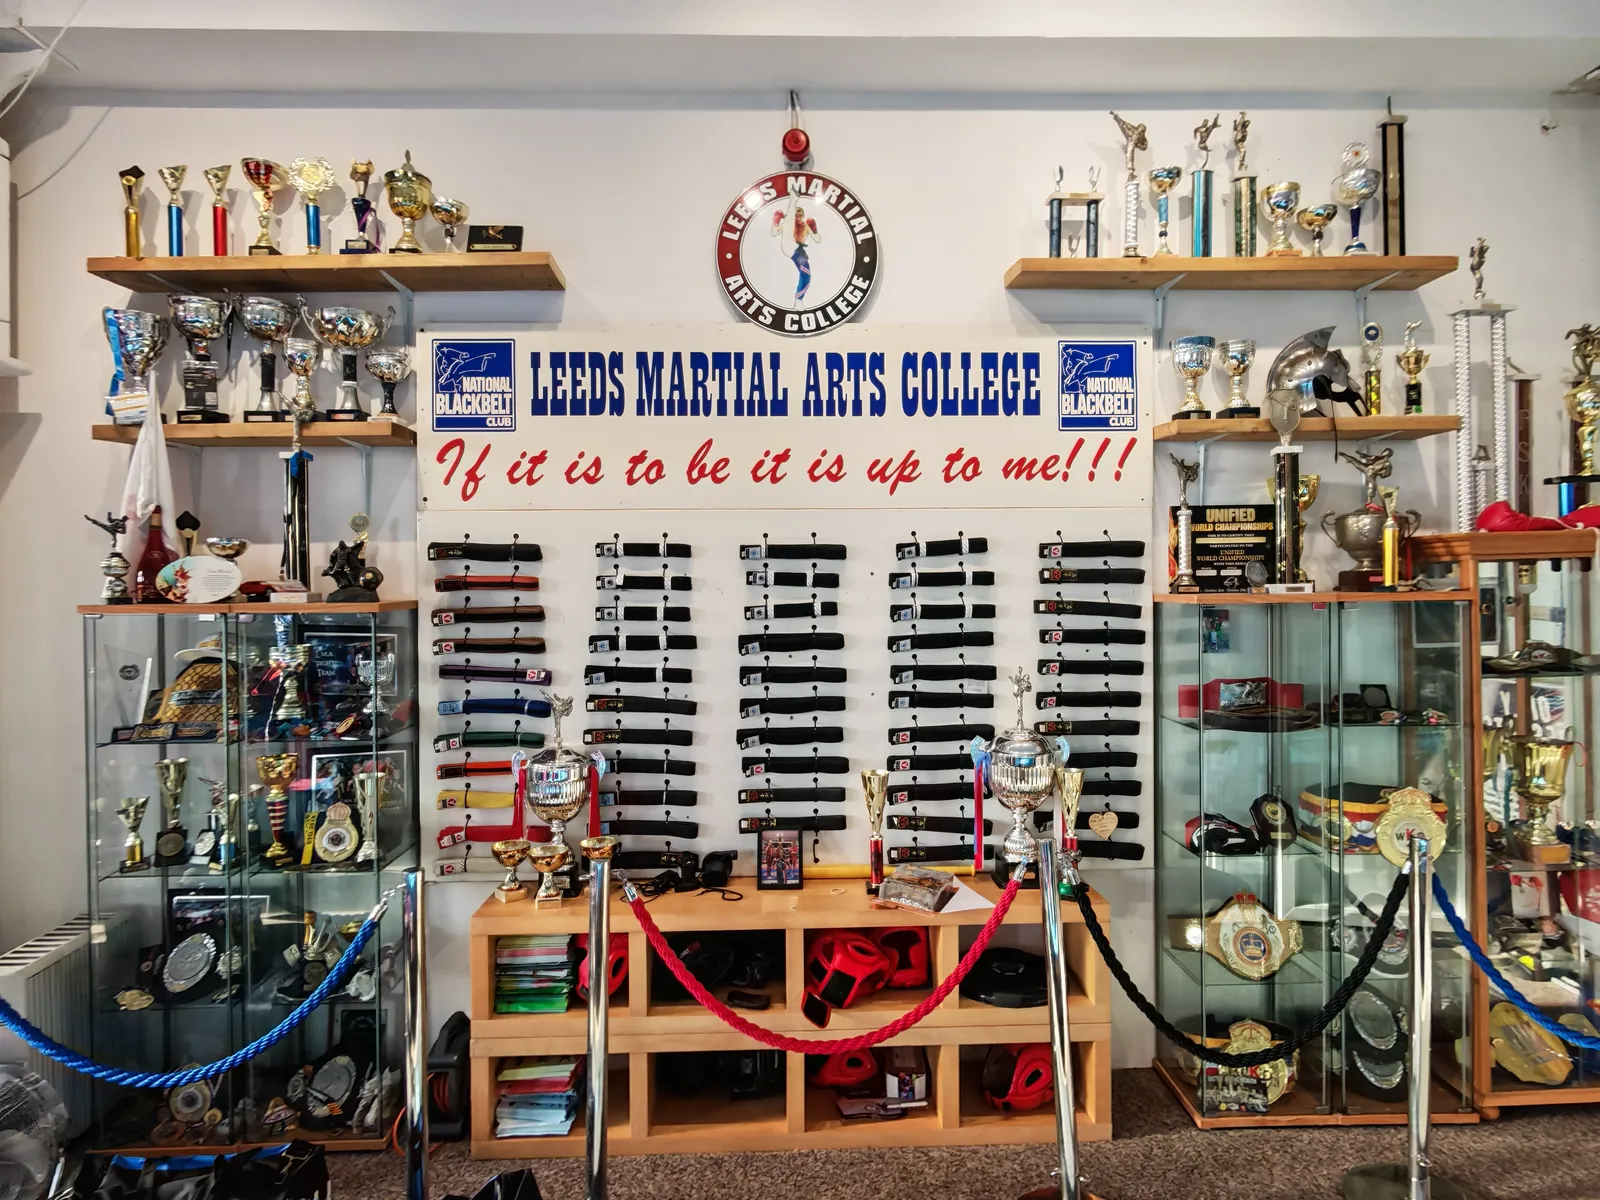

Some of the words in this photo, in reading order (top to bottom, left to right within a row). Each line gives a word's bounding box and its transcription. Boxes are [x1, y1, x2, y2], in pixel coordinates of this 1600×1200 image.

[722, 181, 778, 241] LEEDS
[786, 176, 874, 245] MARTIAL
[725, 274, 777, 325] ARTS
[784, 274, 870, 331] COLLEGE
[462, 376, 512, 393] NATIONAL
[530, 351, 625, 416] LEEDS
[636, 351, 789, 416] MARTIAL
[802, 352, 887, 416] ARTS
[901, 351, 1041, 417] COLLEGE
[1086, 376, 1134, 393] NATIONAL
[436, 393, 512, 415] BLACKBELT
[1061, 393, 1134, 416] BLACKBELT
[486, 417, 512, 427] CLUB
[1108, 417, 1134, 427] CLUB
[436, 437, 492, 502] If
[506, 449, 548, 485] it
[564, 450, 604, 485] is
[625, 449, 667, 486] to
[686, 438, 730, 485] be
[750, 448, 792, 485] it
[807, 449, 847, 483] is
[866, 449, 922, 496] up
[941, 447, 982, 483] to
[1001, 437, 1138, 482] me!!!
[1206, 508, 1256, 522] UNIFIED
[1215, 522, 1274, 531] CHAMPIONSHIPS
